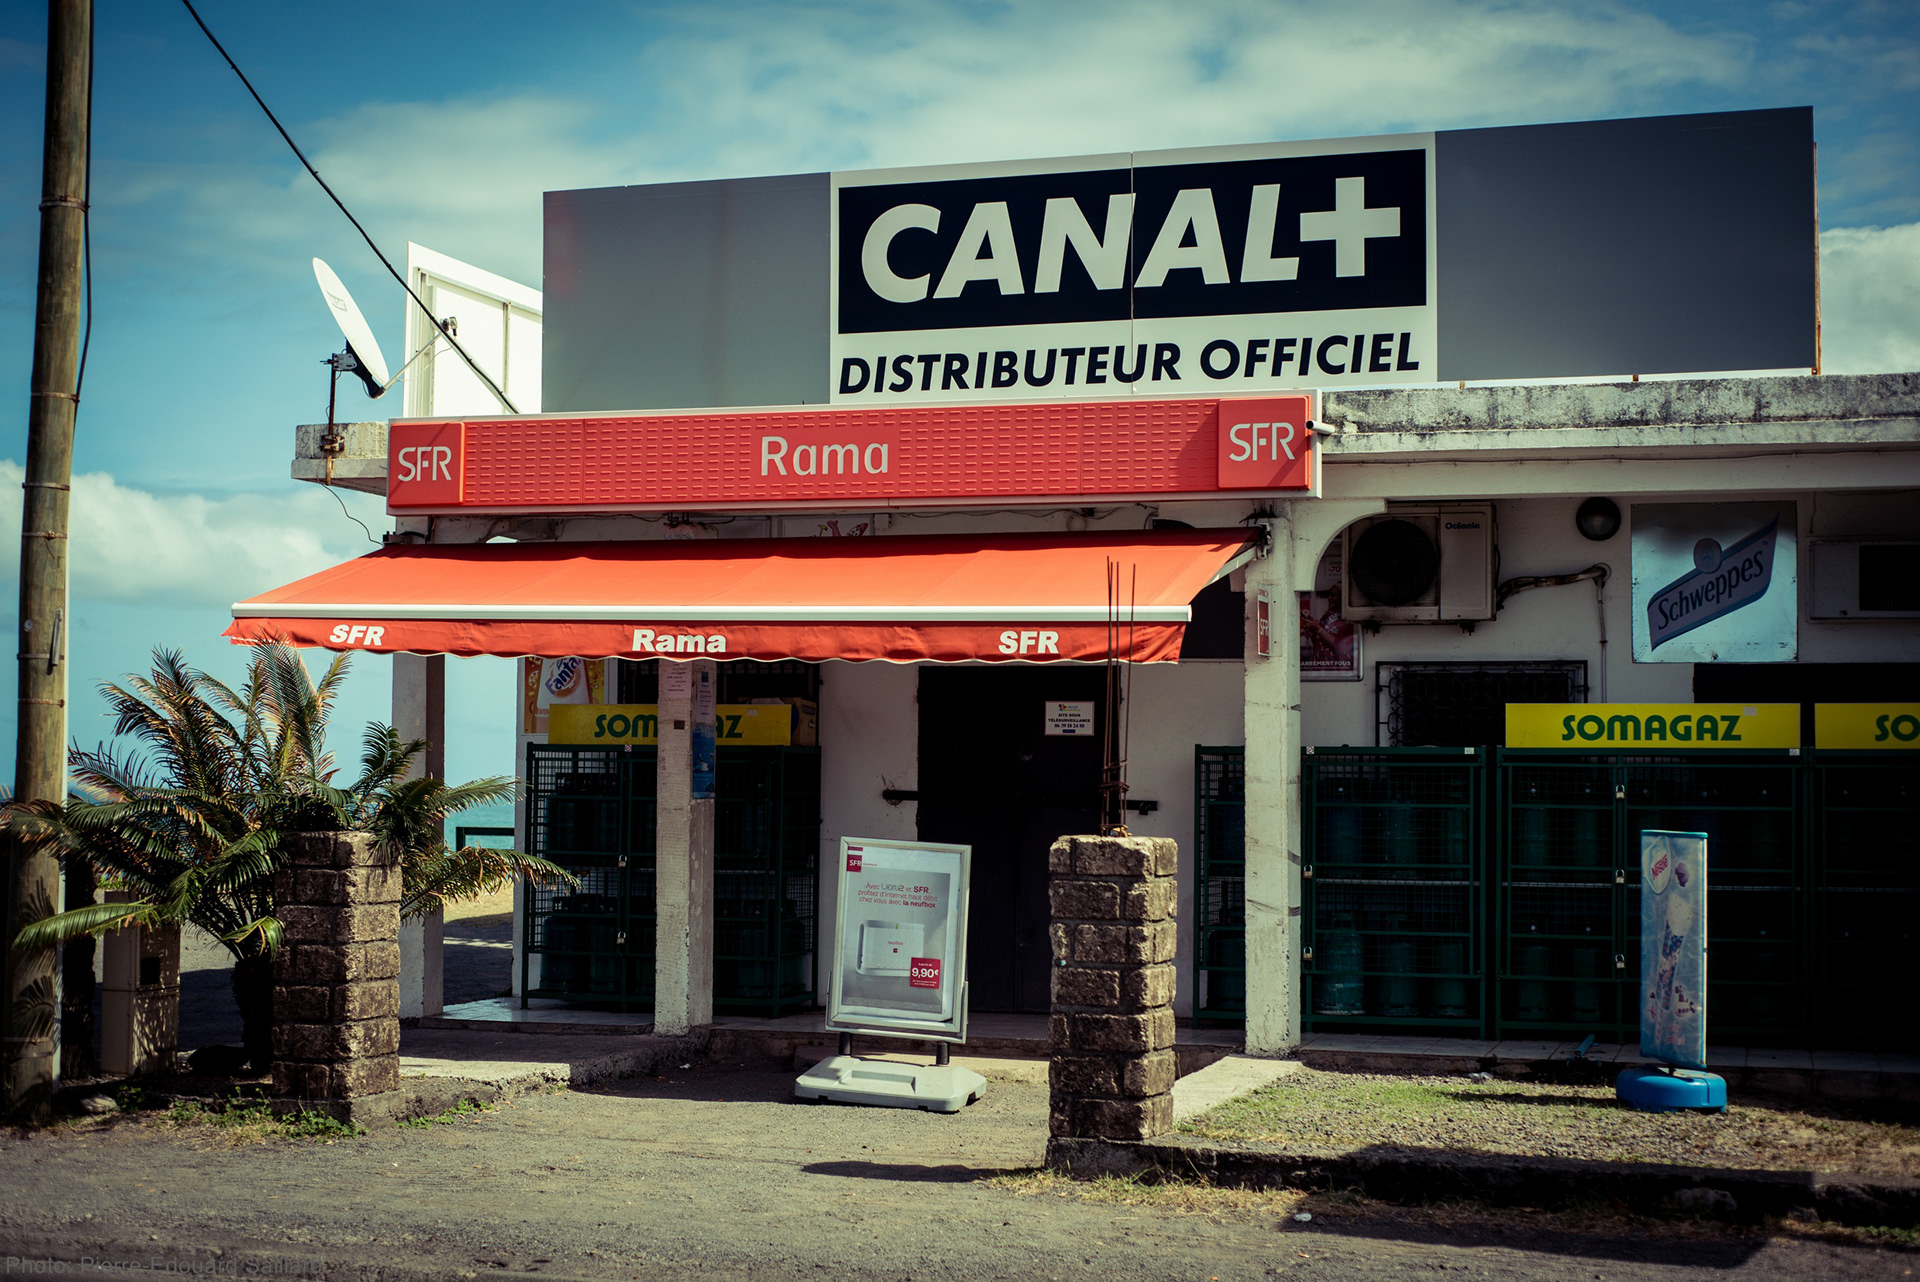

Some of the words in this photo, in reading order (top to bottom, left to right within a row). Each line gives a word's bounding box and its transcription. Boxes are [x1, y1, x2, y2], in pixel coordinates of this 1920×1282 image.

[862, 176, 1400, 303] CANAL+
[839, 342, 1181, 394] DISTRIBUTEUR
[1201, 332, 1420, 379] OFFICIEL
[1229, 421, 1295, 461] SFR
[398, 445, 452, 482] SFR
[761, 435, 889, 477] Rama
[1445, 521, 1480, 529] Océania
[1658, 550, 1764, 630] Schweppes
[330, 624, 385, 647] SFR
[1260, 618, 1268, 637] SFR
[632, 628, 727, 654] Rama
[998, 630, 1059, 654] SFR
[1562, 714, 1742, 742] SOMAGAZ
[849, 859, 862, 867] SFR
[858, 889, 879, 897] profitez
[908, 893, 922, 901] haut
[911, 967, 939, 979] 9,90€
